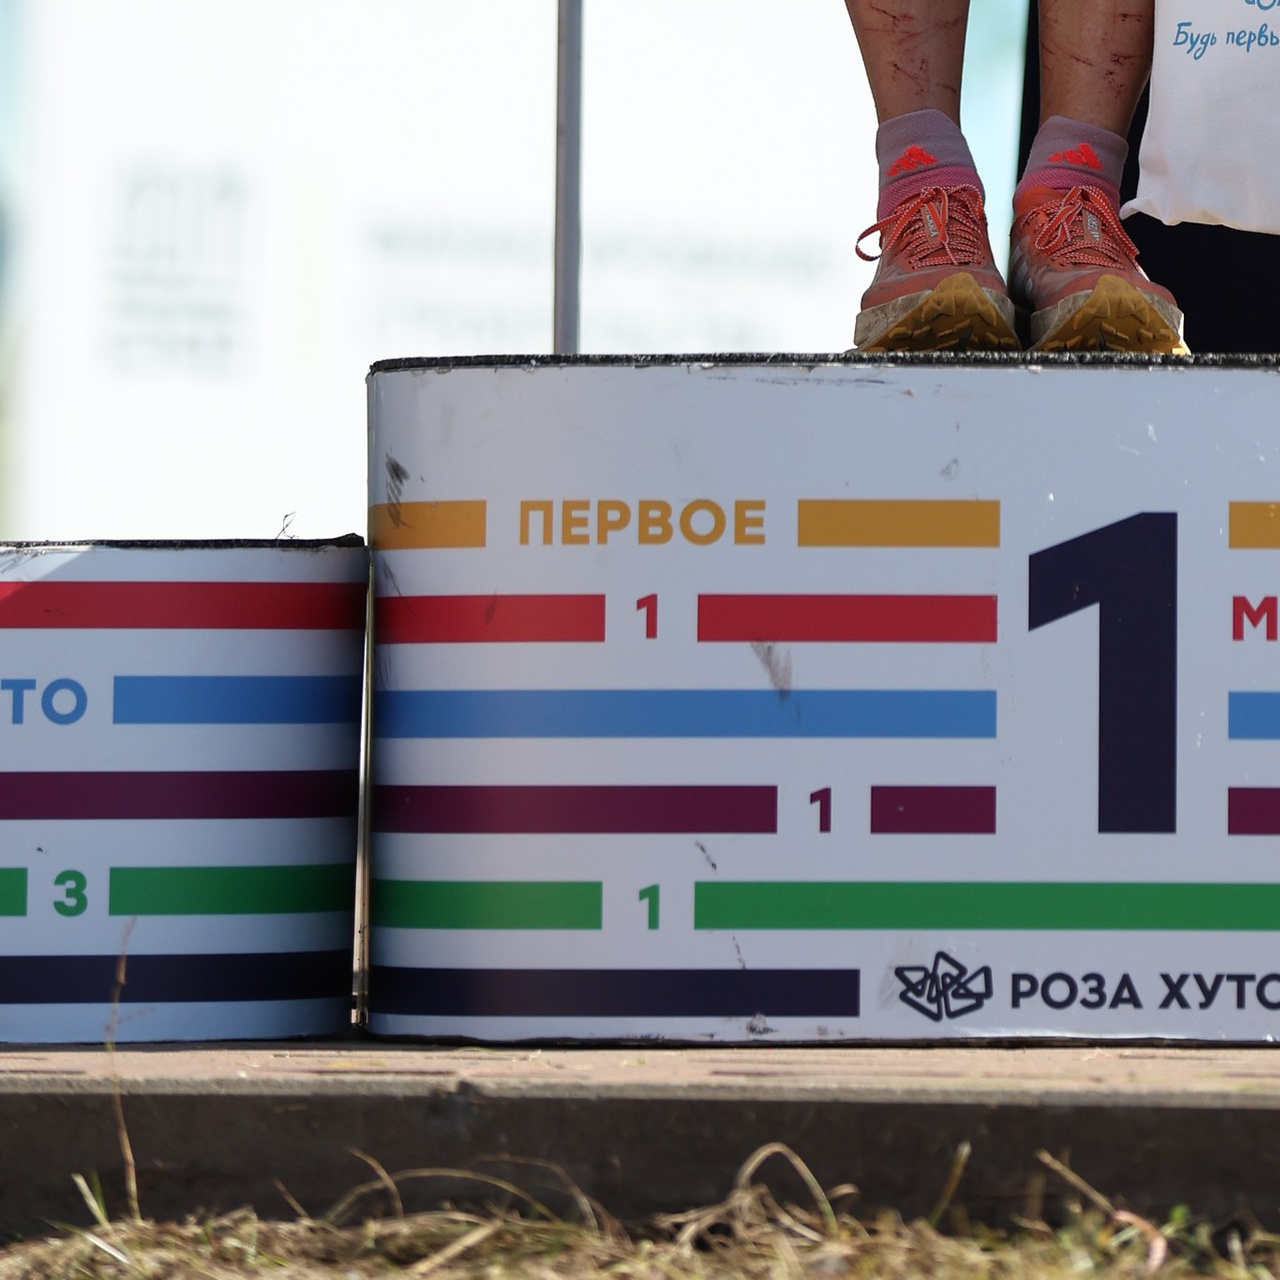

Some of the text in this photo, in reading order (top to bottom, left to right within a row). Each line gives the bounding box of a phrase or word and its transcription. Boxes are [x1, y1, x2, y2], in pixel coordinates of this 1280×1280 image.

[1173, 22, 1217, 59] Будь
[519, 498, 767, 547] ПЕРВОЕ
[636, 593, 658, 639] 1
[1028, 511, 1178, 834] 1
[809, 786, 833, 834] 1
[53, 869, 88, 918] 3
[637, 885, 660, 930] 1
[1010, 971, 1143, 1012] РОЗА
